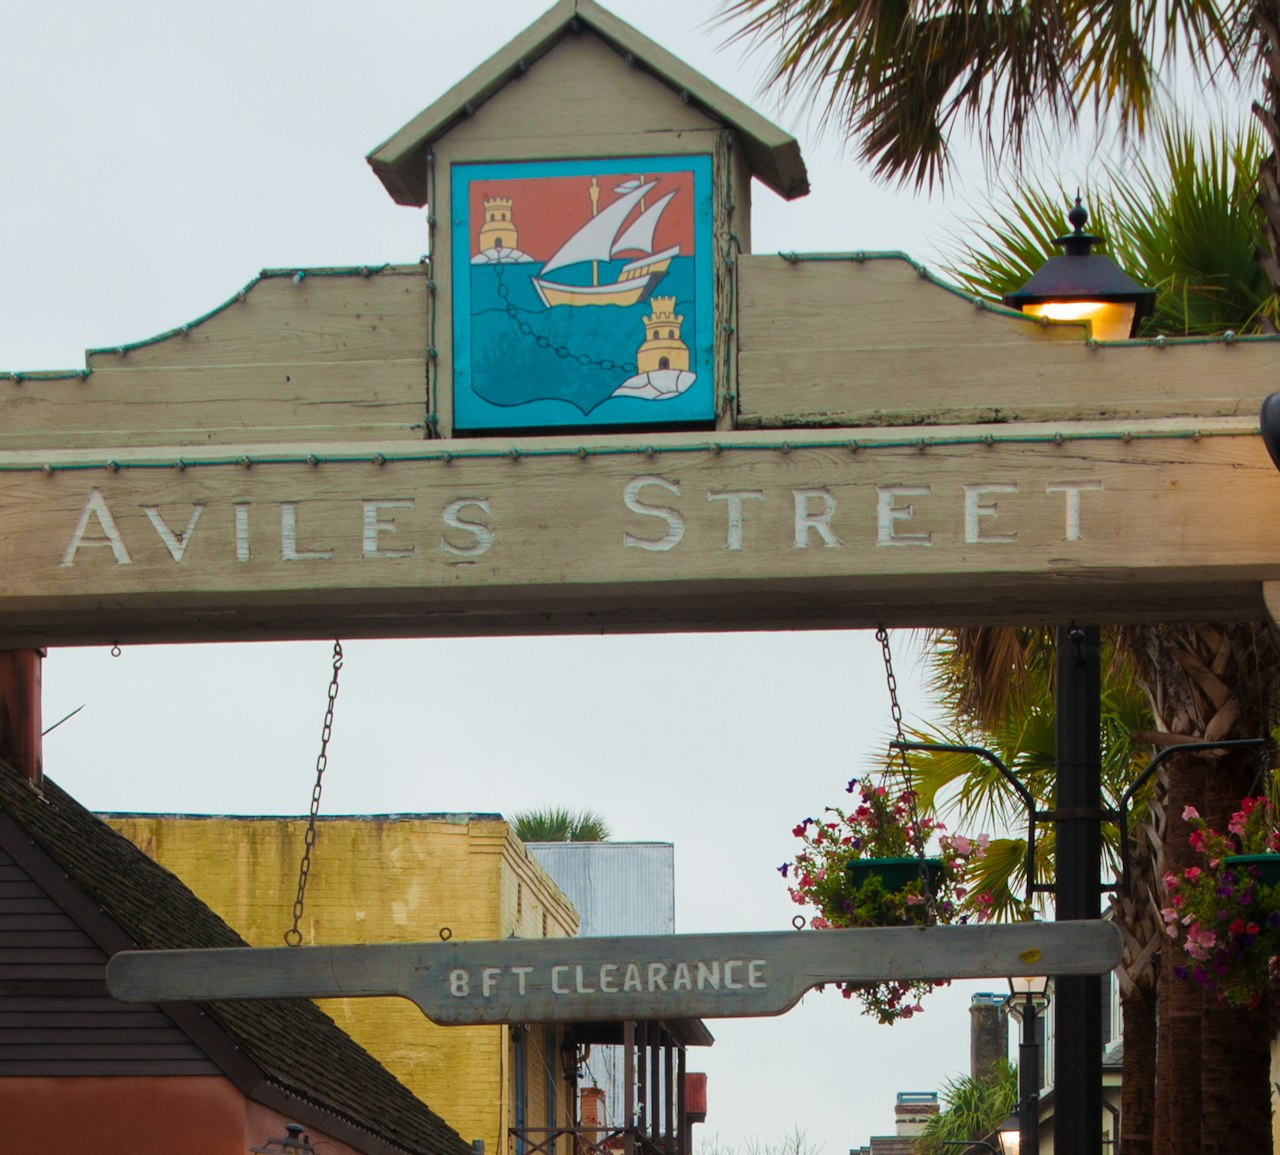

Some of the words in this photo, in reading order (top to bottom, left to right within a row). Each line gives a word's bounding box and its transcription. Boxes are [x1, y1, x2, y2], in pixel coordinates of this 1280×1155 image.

[59, 484, 494, 569] AVILES
[622, 473, 1105, 554] STREET
[551, 959, 767, 994] CLEARANCE
